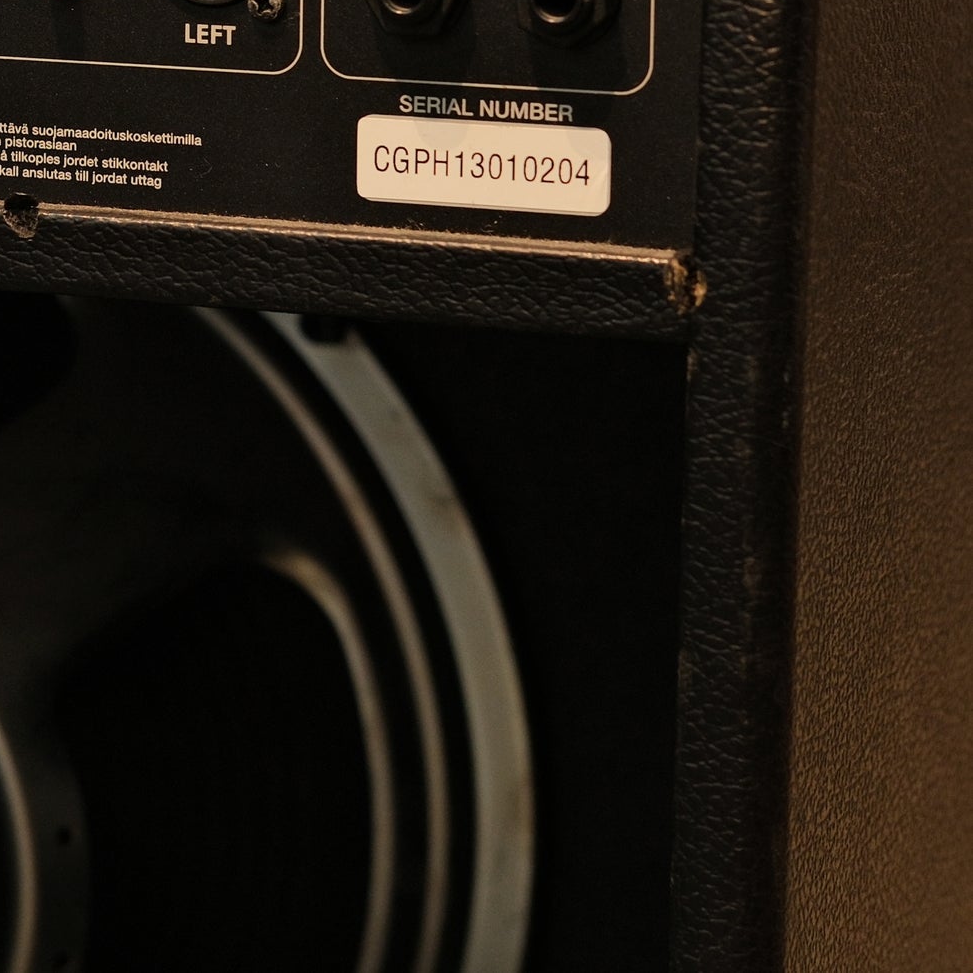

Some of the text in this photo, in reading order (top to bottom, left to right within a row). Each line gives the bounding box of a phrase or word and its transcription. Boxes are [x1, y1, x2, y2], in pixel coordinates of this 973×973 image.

[184, 23, 237, 47] LEFT
[399, 94, 574, 123] SERIAL NUMBER
[4, 135, 77, 151] pistorasiaan
[32, 125, 203, 146] suojamaadoituskoskettimilla
[10, 151, 61, 167] tilkoples
[63, 154, 99, 169] jordet
[101, 157, 169, 173] stikkontakt
[373, 144, 591, 186] CGPH13010204
[22, 167, 72, 181] anslutas
[75, 169, 89, 182] till
[91, 171, 128, 185] jordat
[130, 174, 162, 190] uttag
